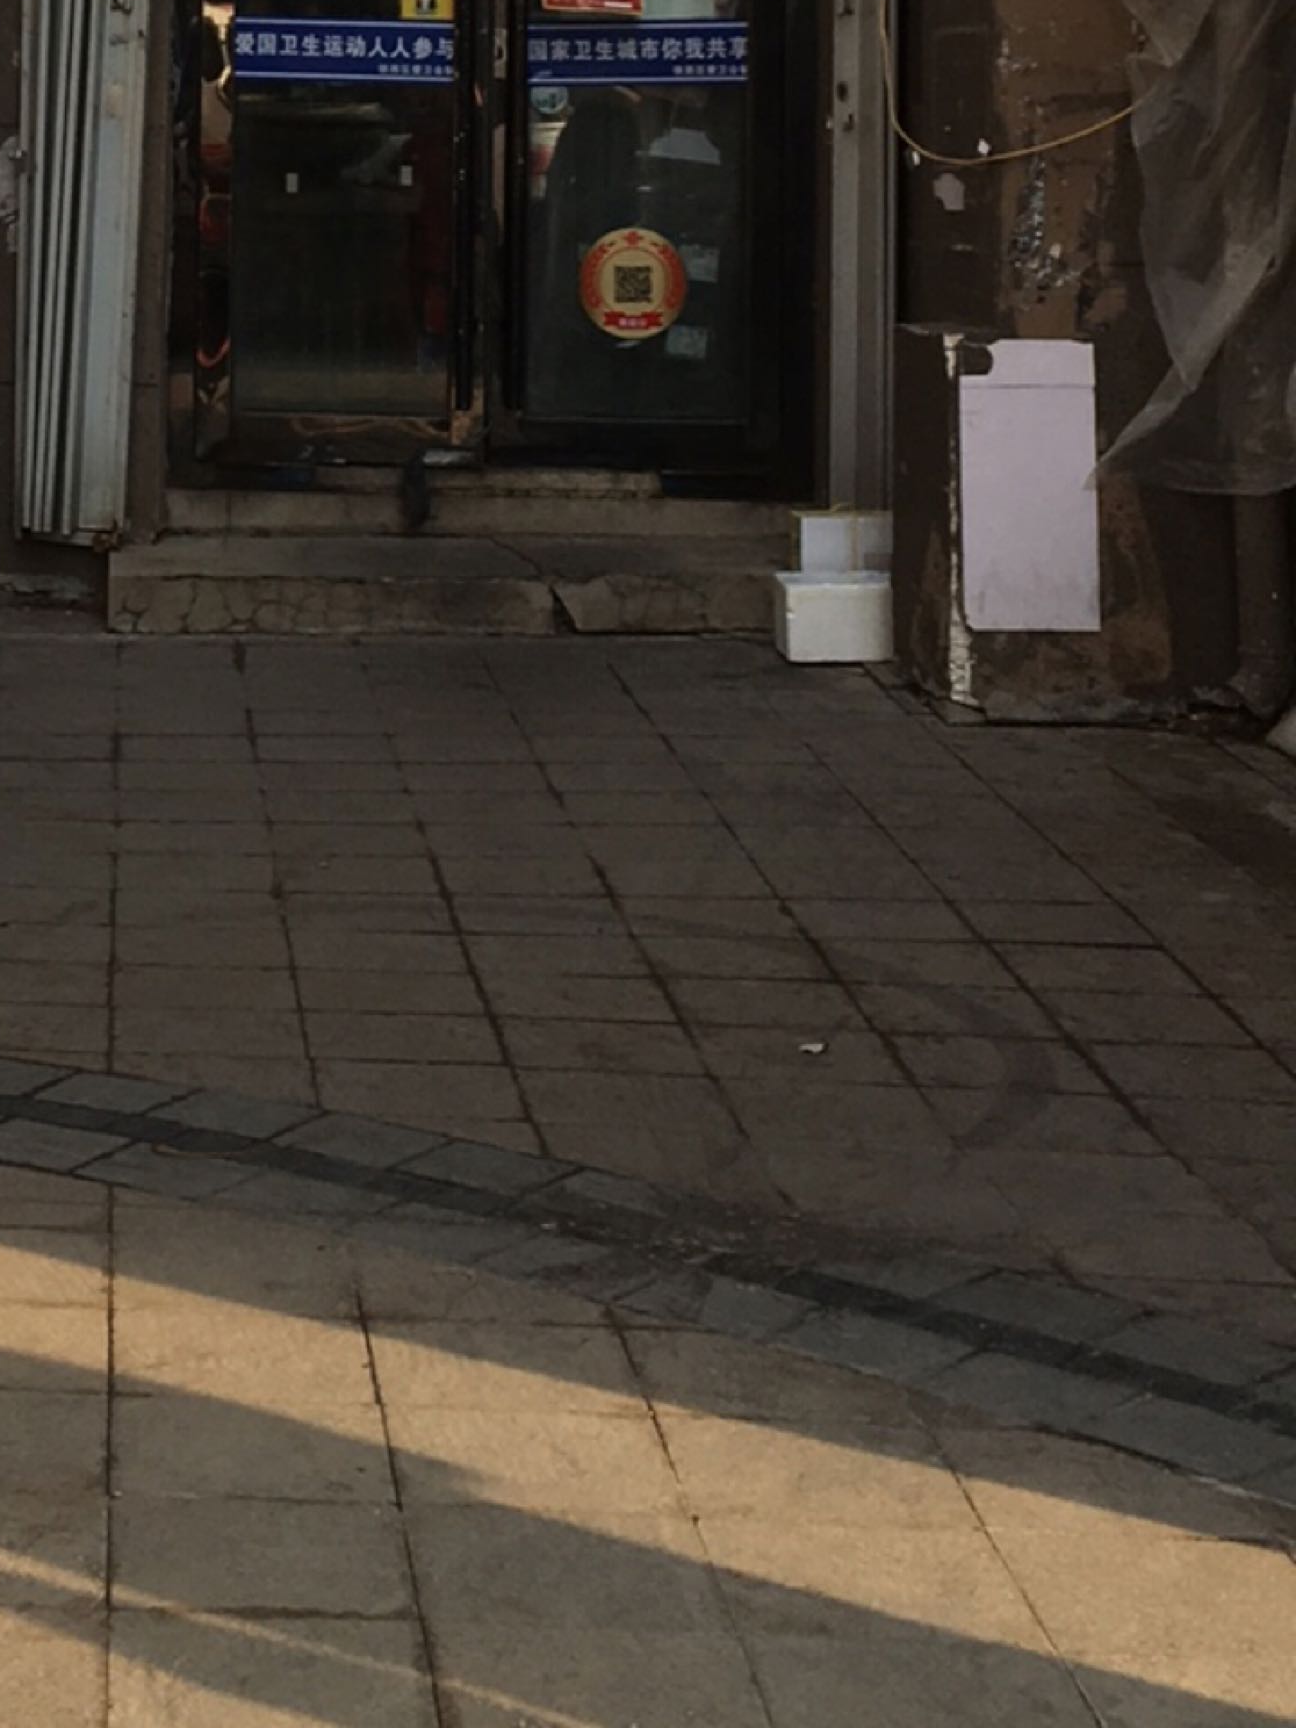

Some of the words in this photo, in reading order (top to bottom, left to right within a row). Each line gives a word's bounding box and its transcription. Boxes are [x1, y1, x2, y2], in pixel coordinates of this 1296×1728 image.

[235, 32, 454, 60] 爱国卫生运动人人参与
[528, 36, 748, 61] 国家卫生城市你我共享
